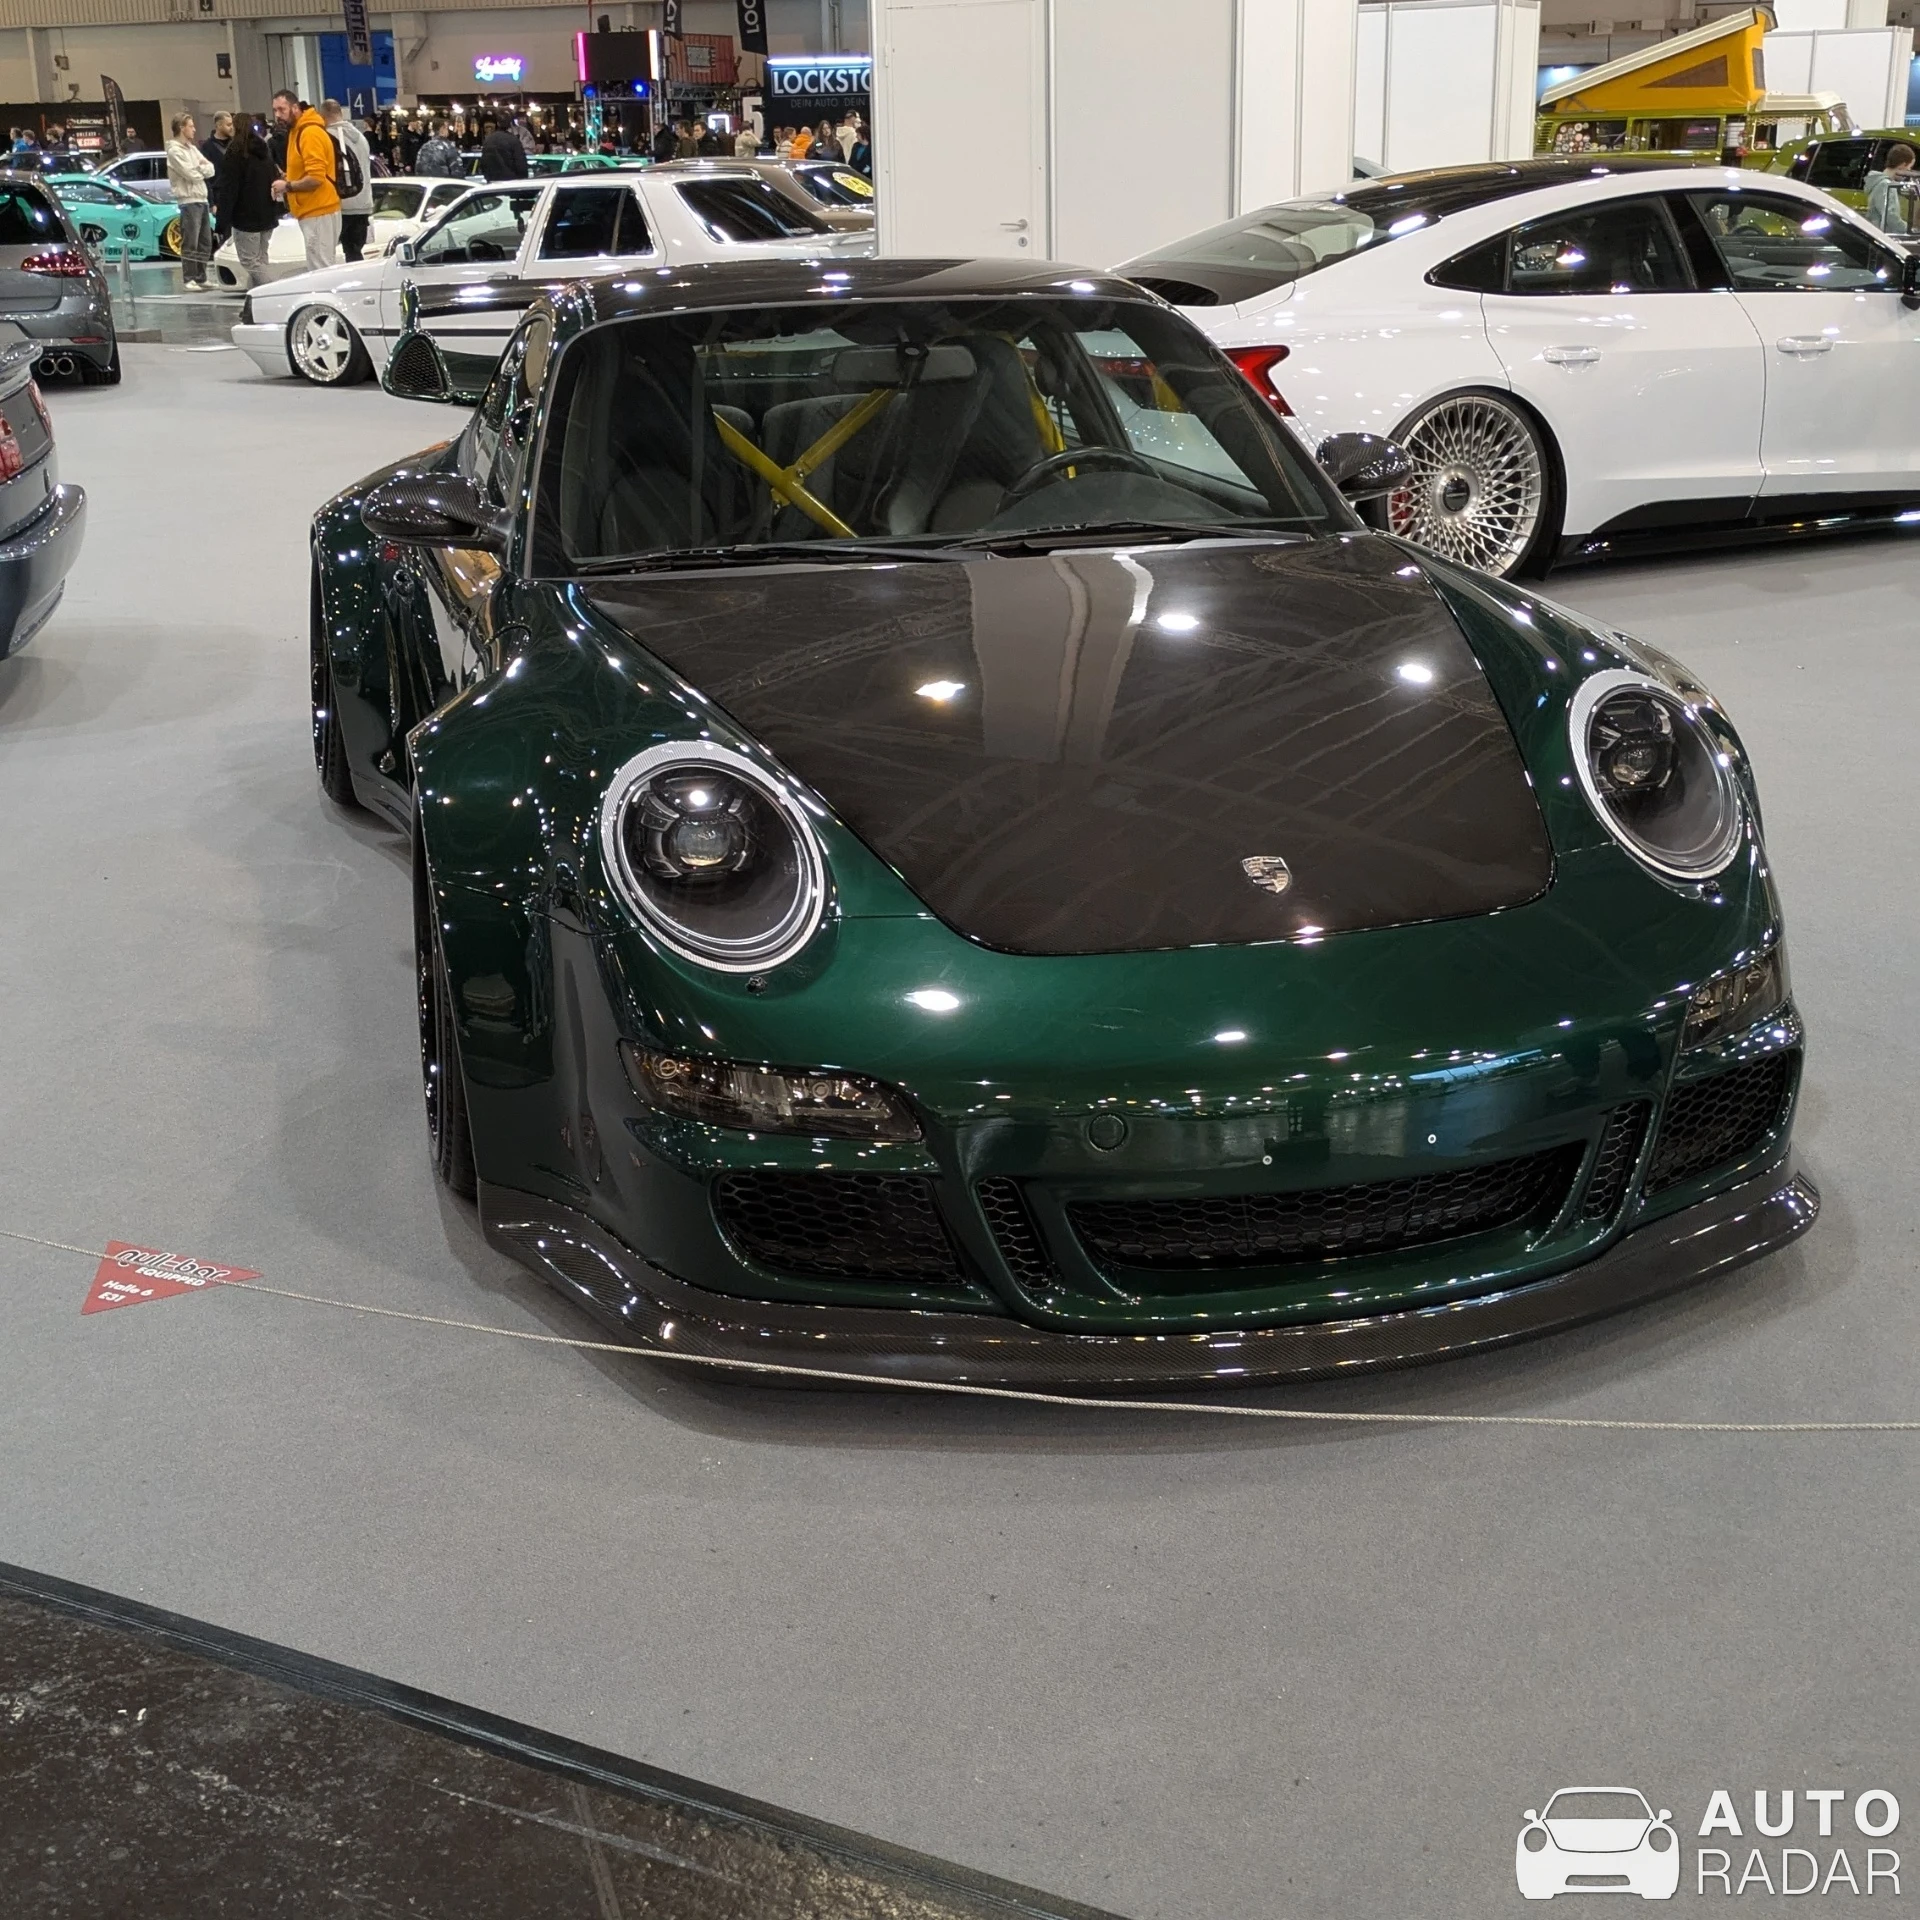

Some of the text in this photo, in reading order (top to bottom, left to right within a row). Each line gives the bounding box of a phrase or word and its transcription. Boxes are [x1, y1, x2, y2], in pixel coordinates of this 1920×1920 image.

[350, 0, 368, 52] ATIEF
[354, 92, 364, 115] 4
[791, 97, 866, 108] DEIN AUTO DEIN
[135, 1266, 206, 1287] EQUIPPED
[102, 1280, 154, 1296] Halle 6
